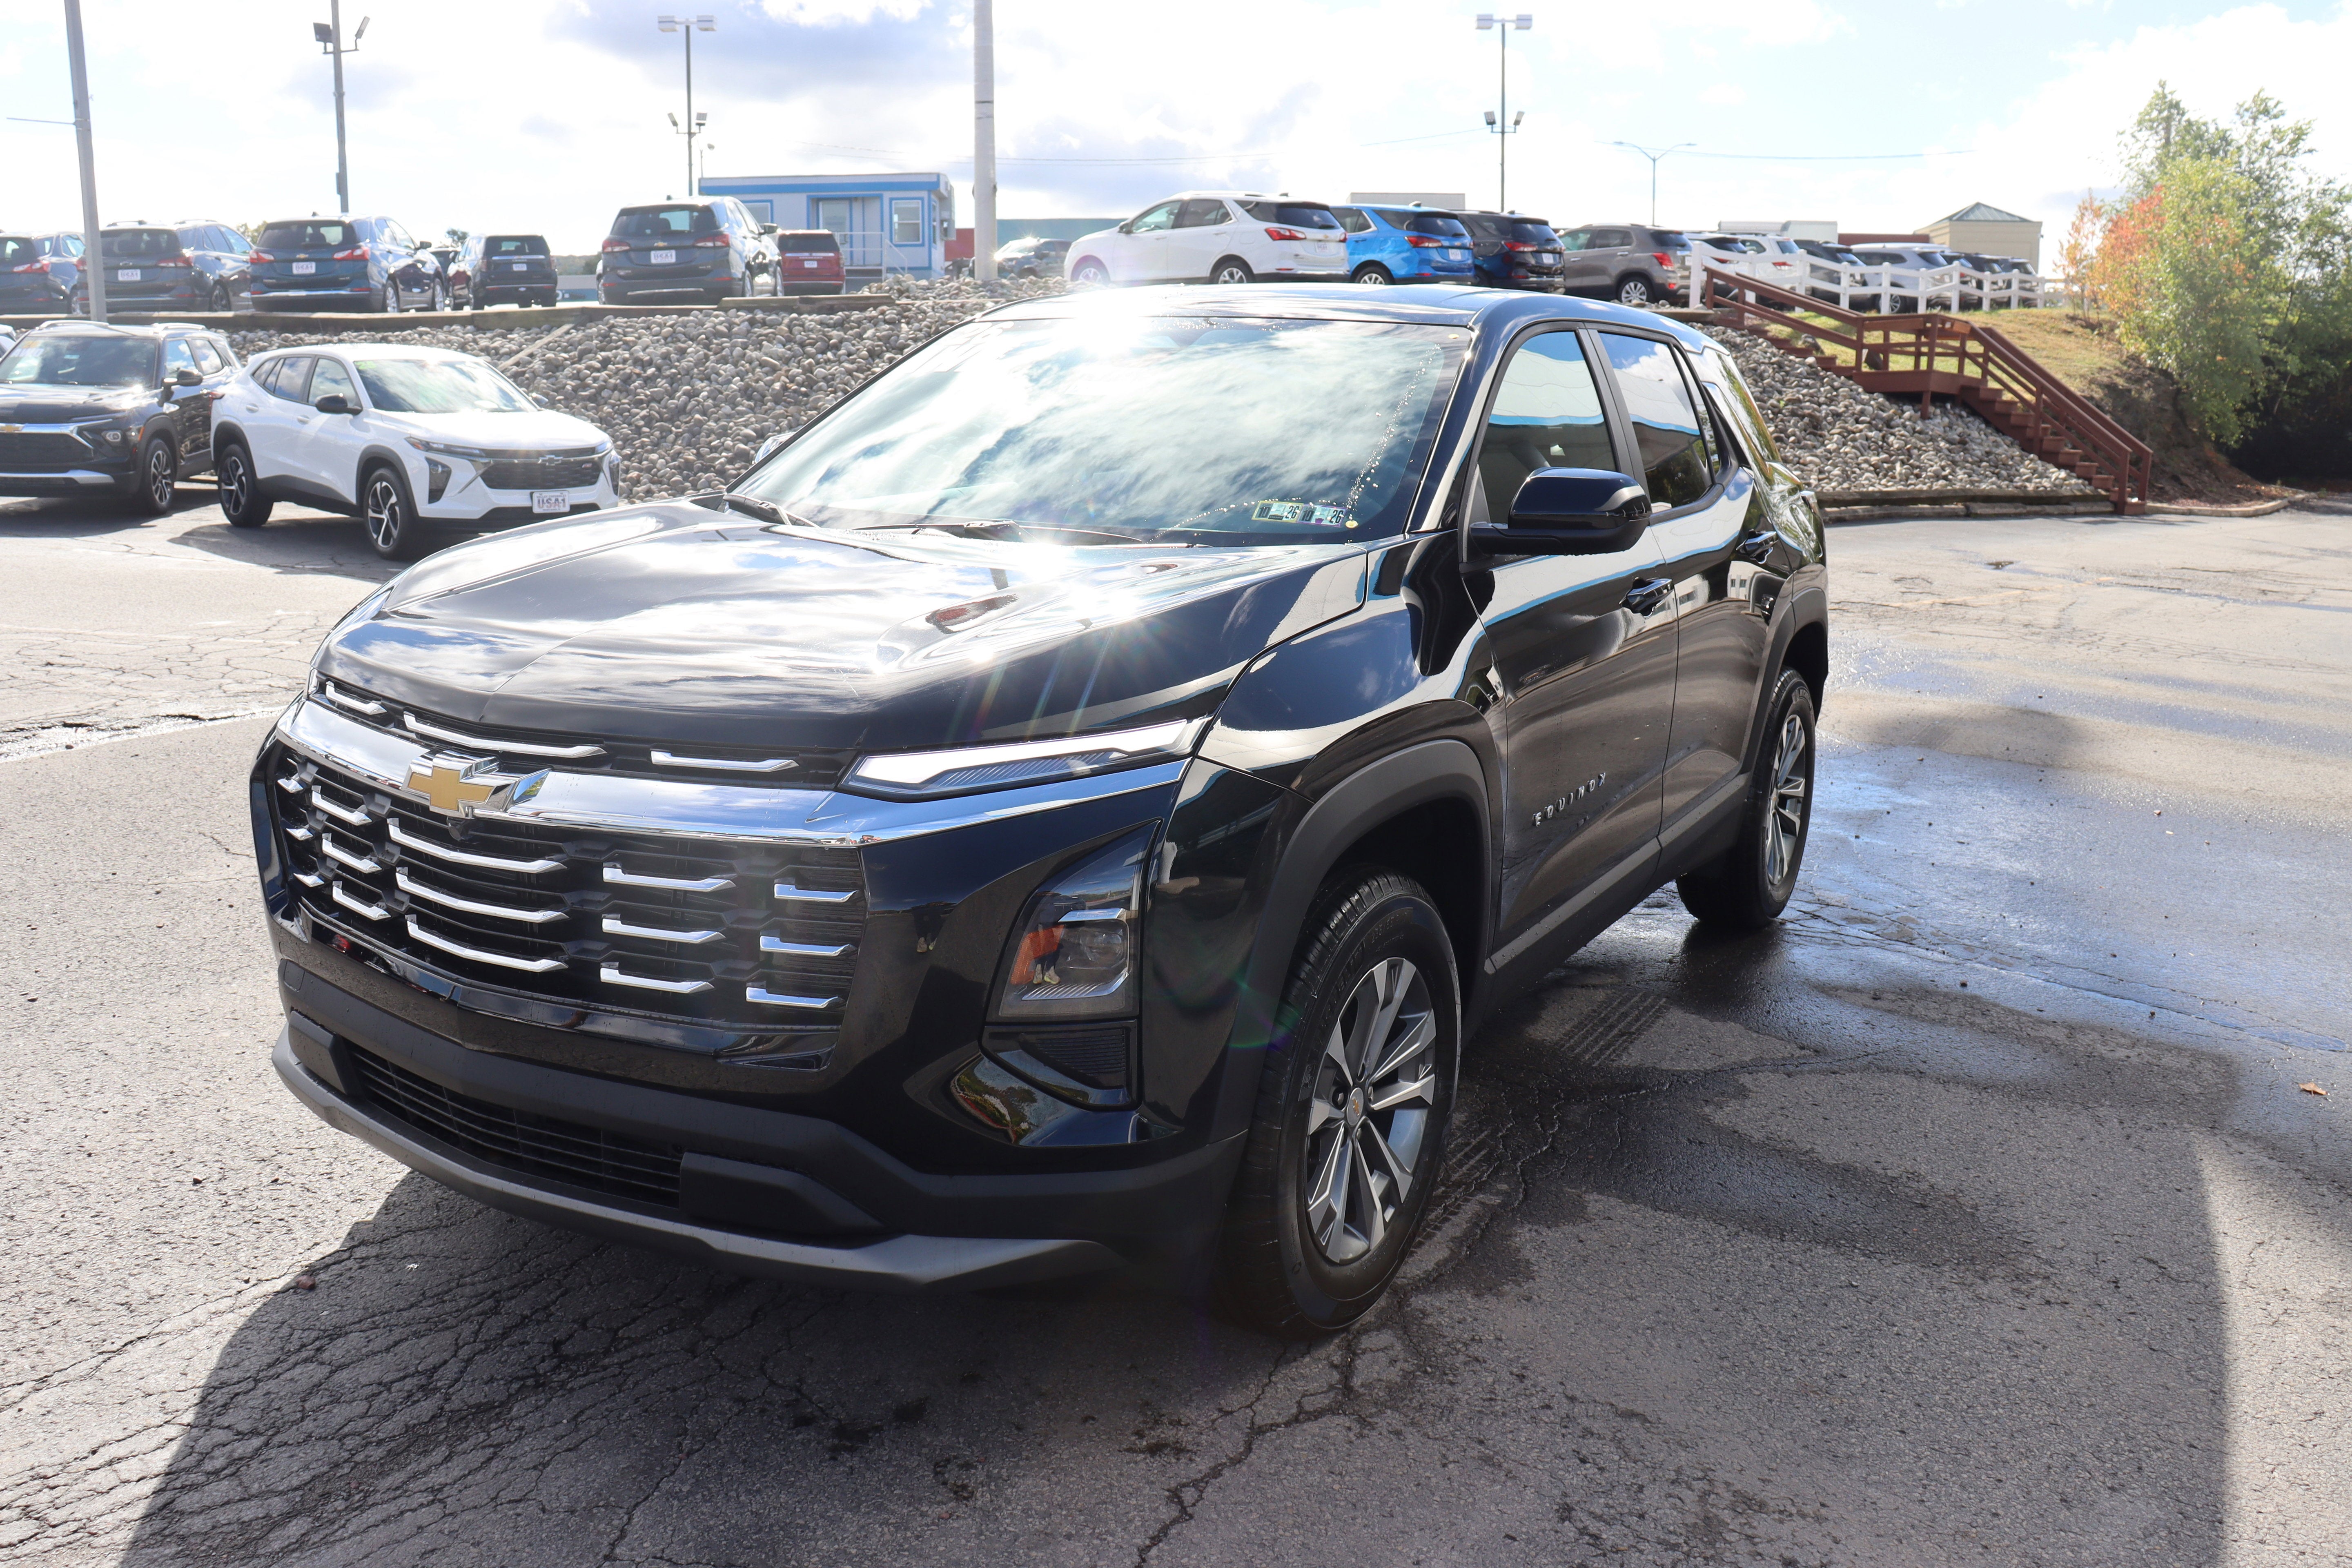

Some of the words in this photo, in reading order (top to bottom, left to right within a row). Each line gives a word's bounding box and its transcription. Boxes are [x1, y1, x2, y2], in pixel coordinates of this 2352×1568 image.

[537, 498, 566, 508] USA1
[1285, 506, 1299, 519] 26
[1330, 509, 1344, 523] 26
[1532, 772, 1606, 828] EQUINOX
